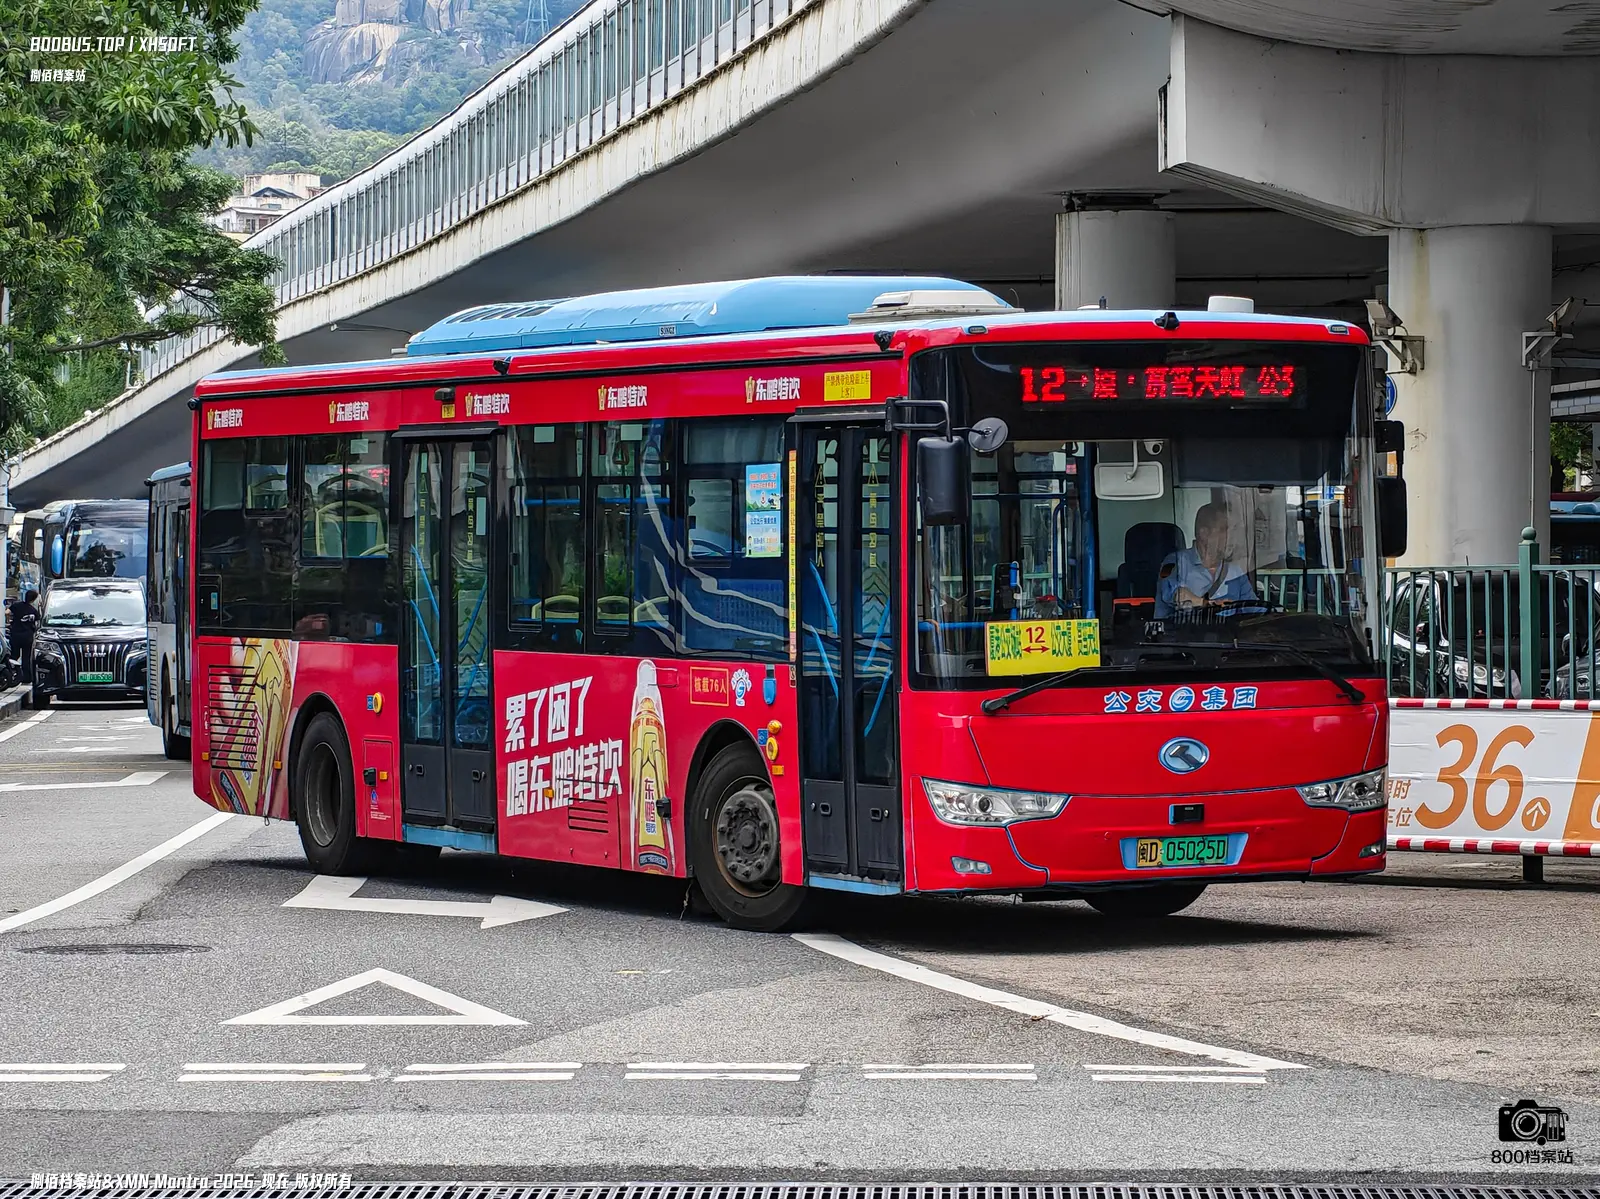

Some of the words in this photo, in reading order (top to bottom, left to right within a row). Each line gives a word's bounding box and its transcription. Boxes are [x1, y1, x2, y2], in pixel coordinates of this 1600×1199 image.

[607, 385, 648, 409] 东鹏特饮
[755, 377, 801, 402] 东鹏特饮
[1020, 367, 1065, 402] 12
[336, 401, 369, 422] 东鹏特饮
[473, 393, 510, 416] 东鹏特饮
[213, 409, 243, 430] 东鹏特饮
[1026, 626, 1046, 644] 12
[1104, 689, 1163, 713] 公交
[1201, 686, 1258, 710] 集团
[505, 676, 593, 753] 累了困了
[506, 737, 623, 817] 喝东鹏特饮
[1414, 724, 1535, 831] 36
